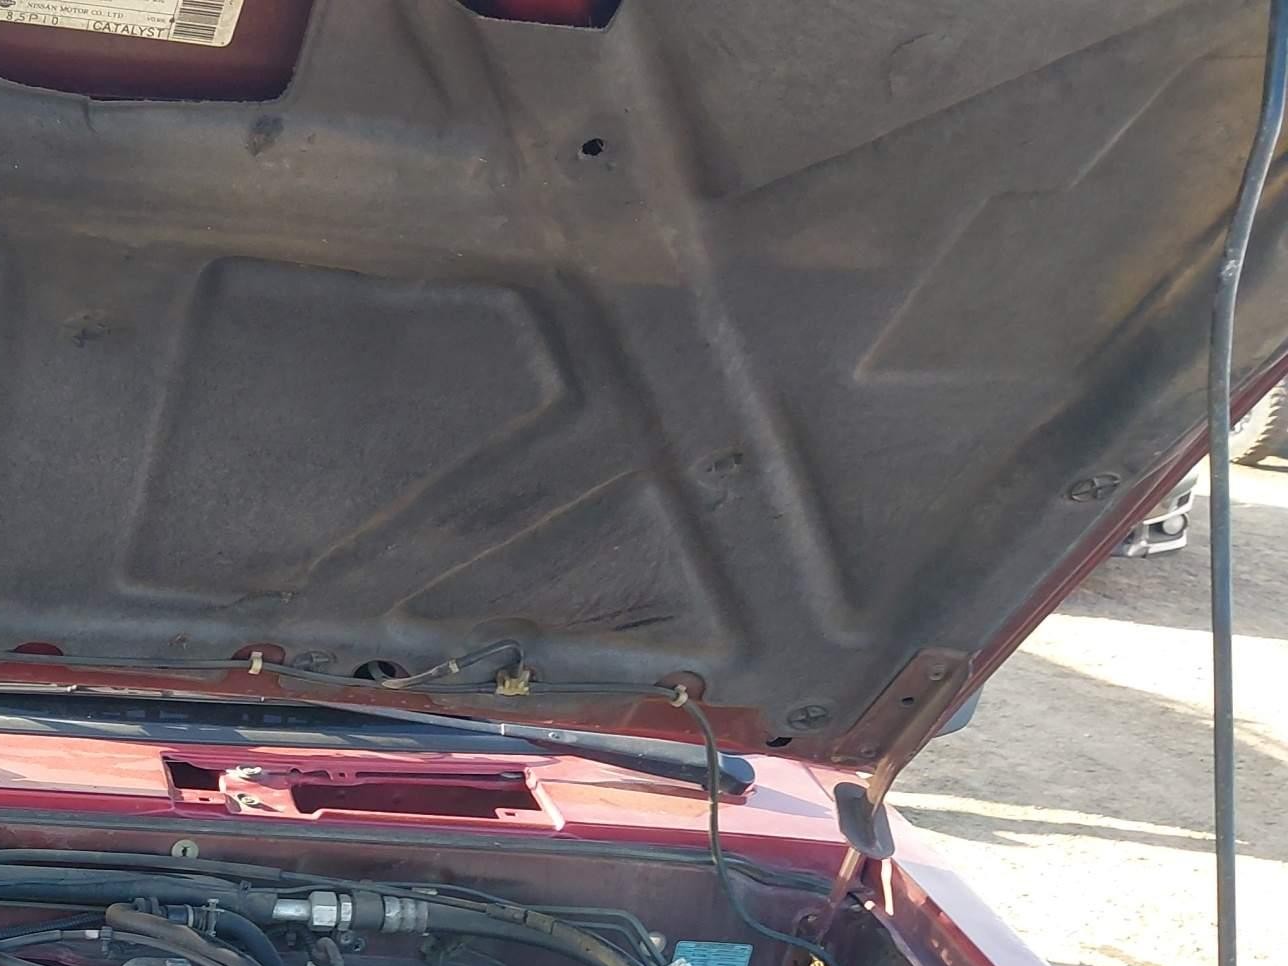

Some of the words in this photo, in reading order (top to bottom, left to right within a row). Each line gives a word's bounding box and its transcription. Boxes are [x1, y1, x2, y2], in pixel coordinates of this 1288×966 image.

[26, 2, 58, 11] NISSAN
[60, 5, 89, 14] MOTOR
[92, 20, 165, 38] CATALYST
